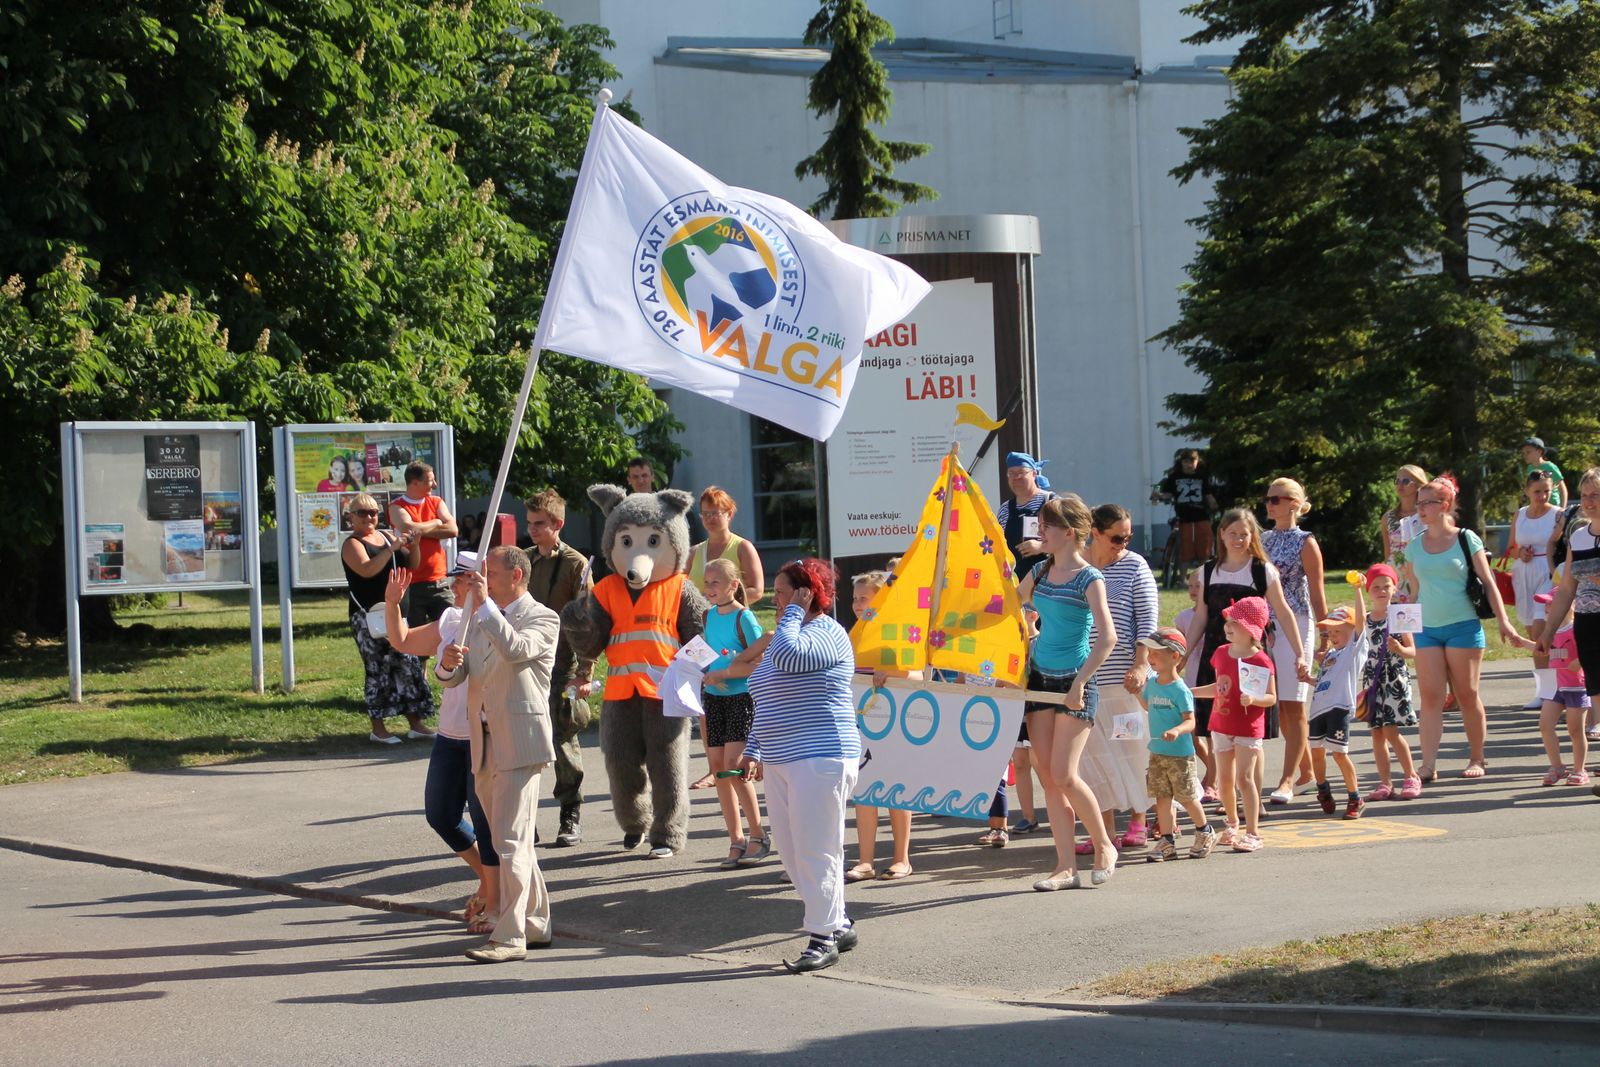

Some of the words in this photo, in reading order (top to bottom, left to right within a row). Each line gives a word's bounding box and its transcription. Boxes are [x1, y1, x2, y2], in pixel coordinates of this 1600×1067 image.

[714, 223, 745, 242] 2016
[896, 230, 946, 242] PRISMA
[948, 230, 971, 241] NET
[640, 225, 666, 304] AASTAT
[653, 310, 685, 341] 730
[773, 315, 803, 339] linn,
[806, 326, 819, 341] 2
[821, 333, 846, 350] riiki
[696, 309, 842, 399] VALGA
[920, 353, 975, 369] töötajaga
[149, 467, 201, 479] SEREBRO
[847, 512, 868, 521] Vaata
